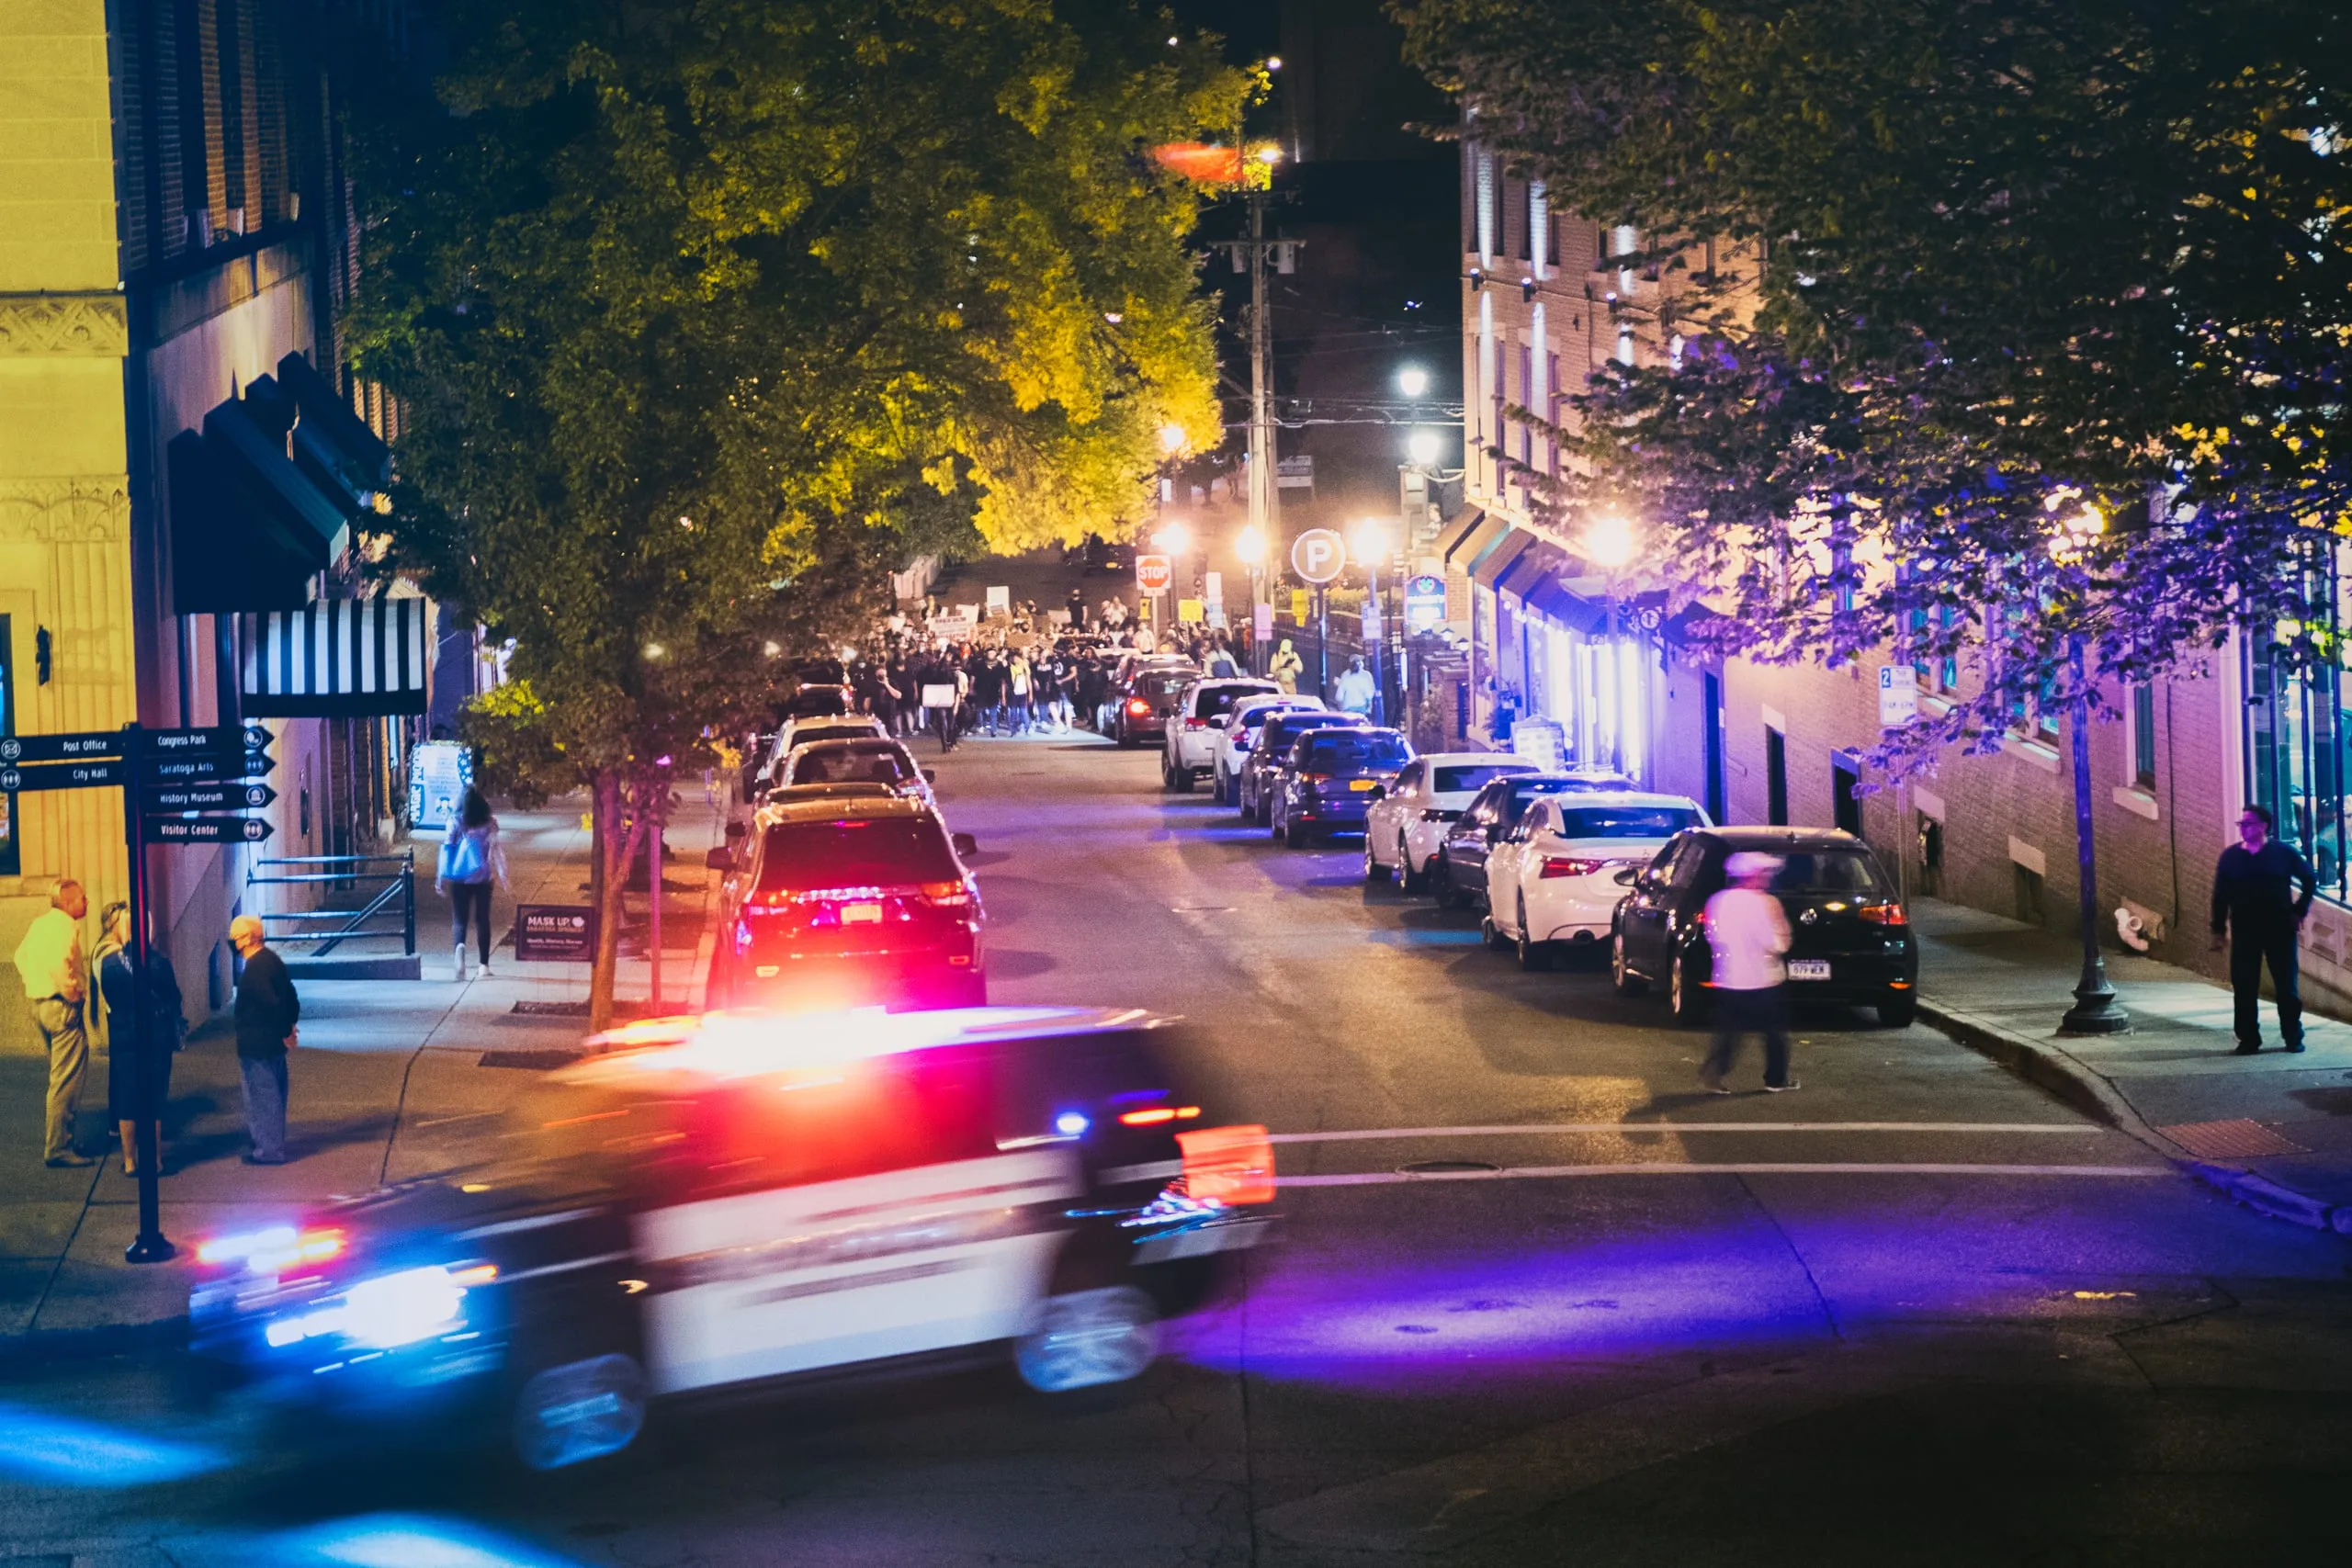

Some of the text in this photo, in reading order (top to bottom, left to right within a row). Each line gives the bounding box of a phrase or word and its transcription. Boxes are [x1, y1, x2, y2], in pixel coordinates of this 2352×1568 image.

[1306, 539, 1332, 572] P
[1139, 566, 1168, 580] STOP
[1882, 670, 1890, 685] 2
[63, 739, 107, 751] Post Office
[158, 734, 207, 749] Congress Park
[73, 767, 107, 782] City Hall
[159, 761, 214, 775] Saratoga Arts
[160, 792, 223, 805] History Museum
[161, 823, 219, 836] Visitor Center
[527, 916, 556, 927] MASK
